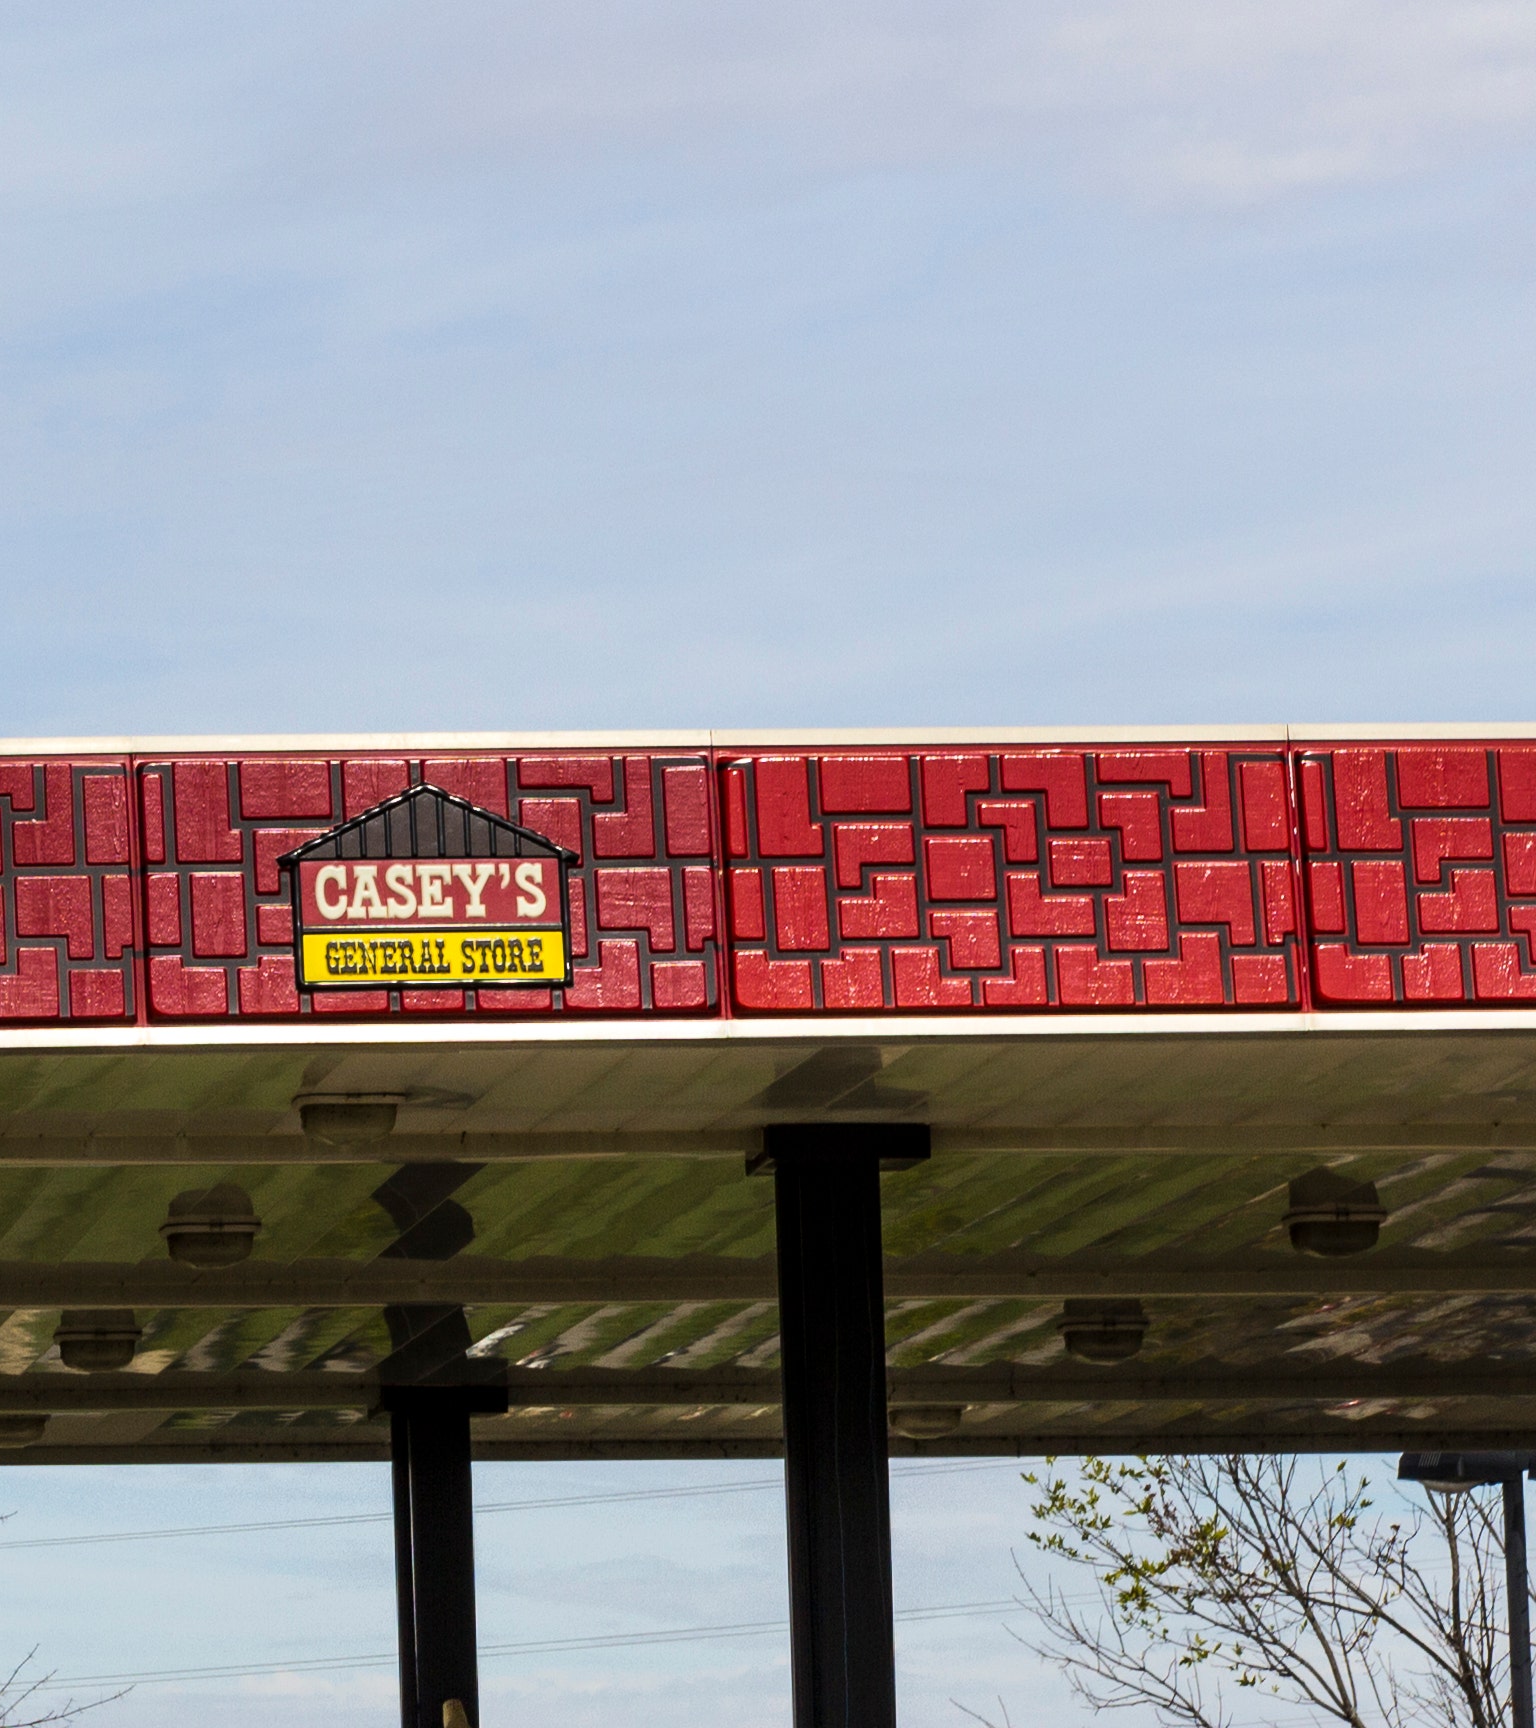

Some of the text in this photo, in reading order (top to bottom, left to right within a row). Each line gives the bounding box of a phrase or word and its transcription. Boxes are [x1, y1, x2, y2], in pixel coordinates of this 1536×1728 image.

[315, 862, 547, 920] CASEY'S
[325, 937, 545, 975] GENERAL STORE
